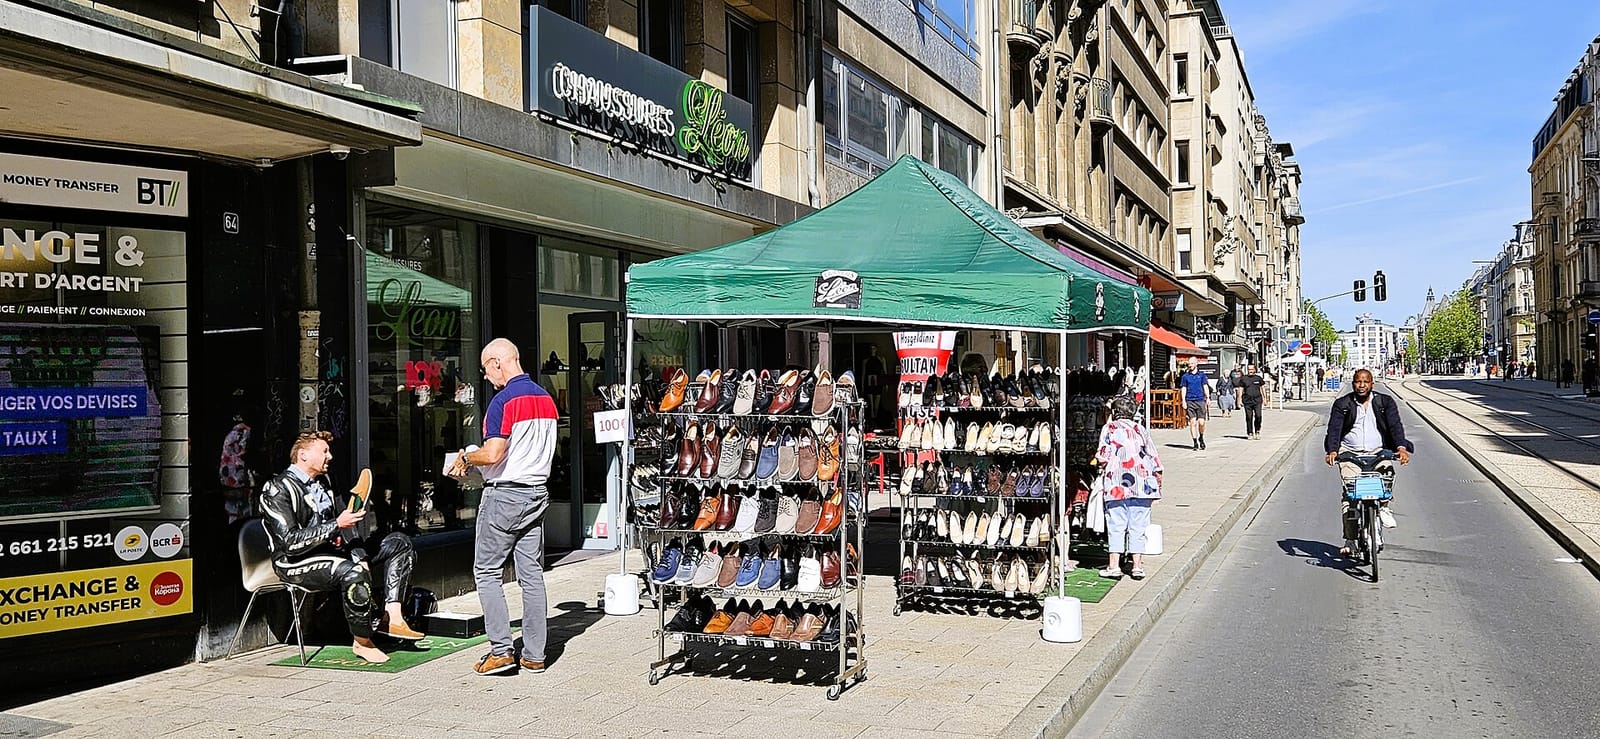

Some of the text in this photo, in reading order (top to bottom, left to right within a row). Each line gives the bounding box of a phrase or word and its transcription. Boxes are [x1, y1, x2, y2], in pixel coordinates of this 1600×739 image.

[3, 174, 119, 193] MONEY TRANSFER
[225, 215, 237, 230] 64
[3, 228, 145, 267] NGE &
[0, 272, 144, 292] RT D'ARGENT
[27, 306, 79, 315] PAIEMENT
[89, 307, 146, 317] CONNEXION
[40, 395, 73, 410] VOS
[76, 394, 138, 409] DEVISES
[3, 430, 57, 447] TAUX !
[9, 539, 43, 555] 661
[47, 536, 79, 552] 215
[83, 532, 114, 548] 521
[153, 538, 171, 548] BCR
[0, 575, 140, 606] XCHANGE &
[0, 597, 142, 625] ONEY TRANSFER
